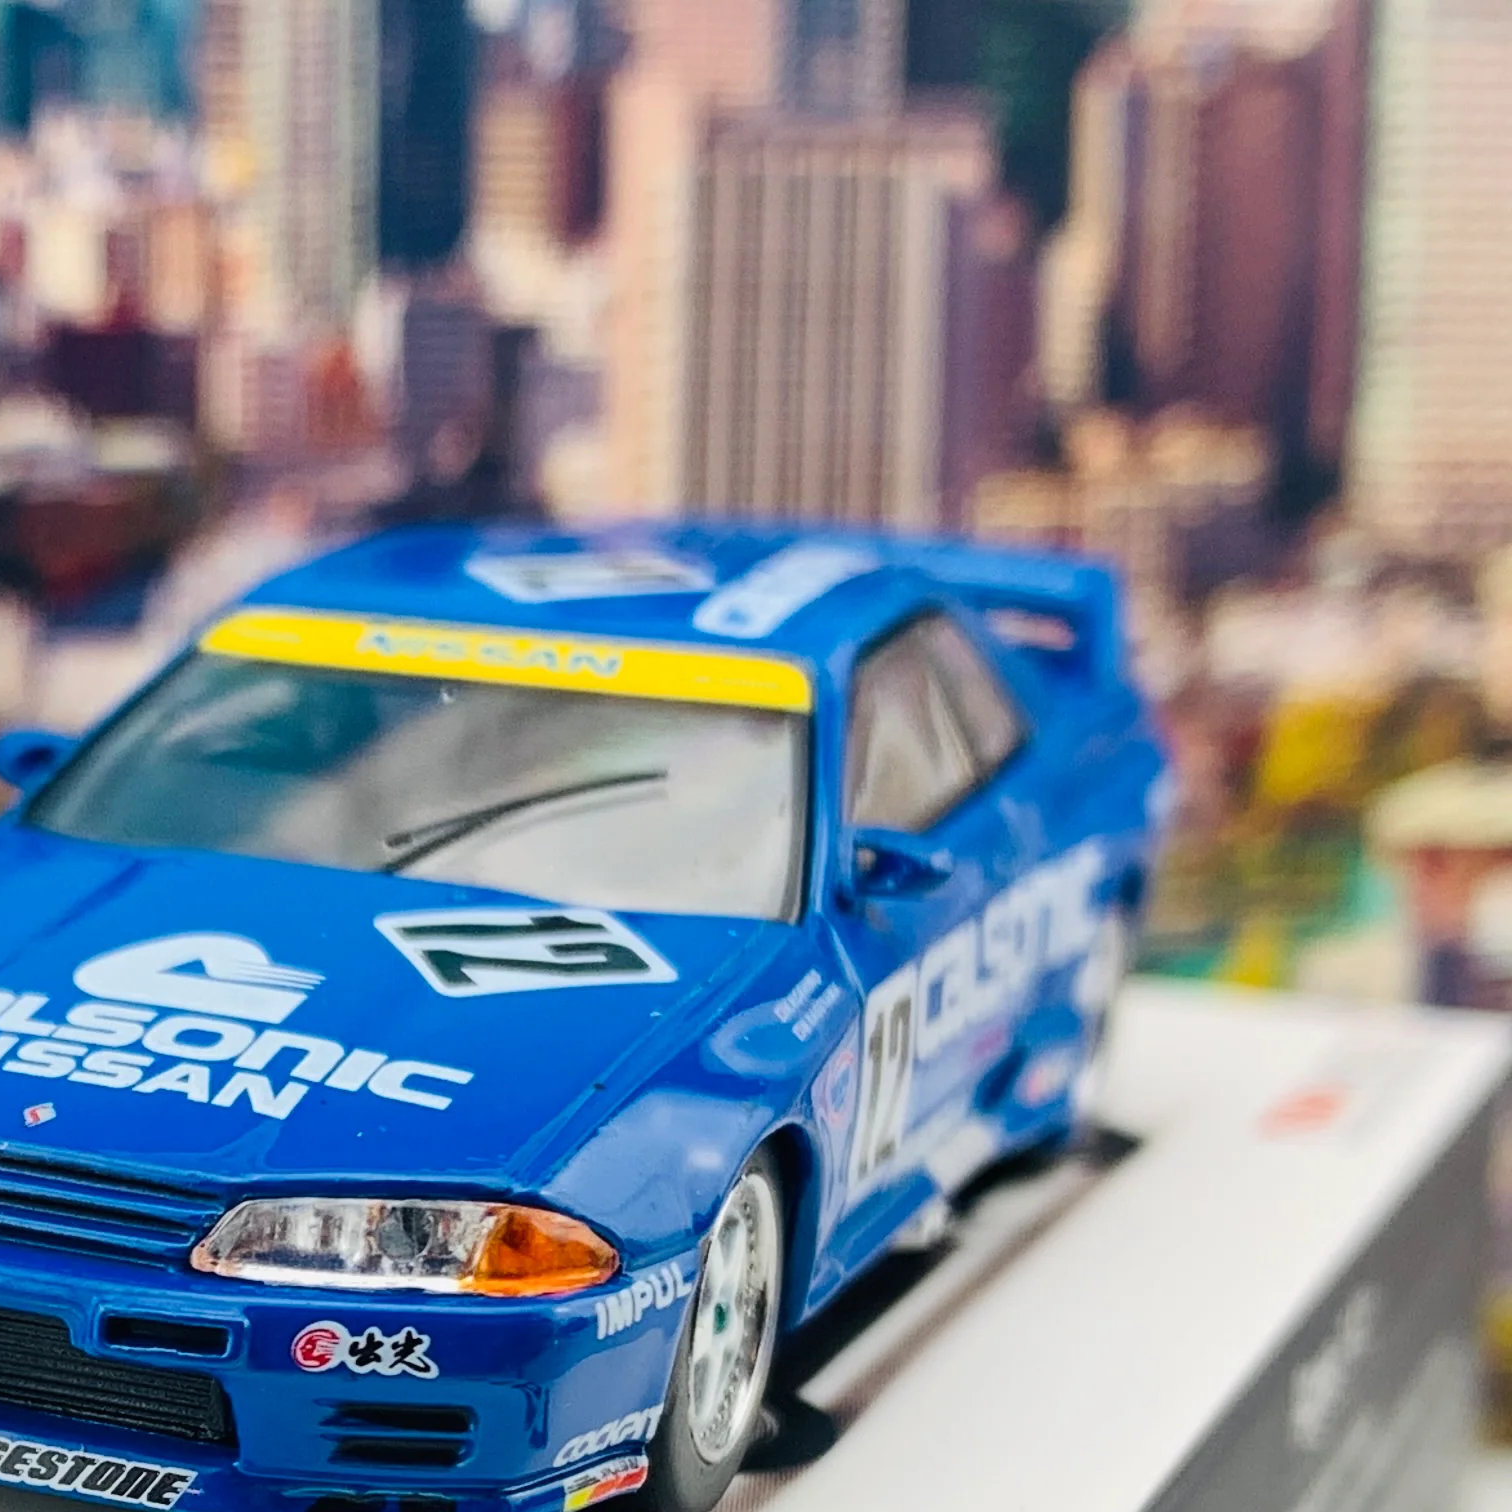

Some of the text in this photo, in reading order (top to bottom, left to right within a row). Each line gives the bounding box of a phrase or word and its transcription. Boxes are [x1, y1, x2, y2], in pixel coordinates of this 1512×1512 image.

[356, 625, 623, 680] NISSAN
[394, 913, 652, 989] 12
[856, 995, 913, 1180] 12
[595, 1260, 693, 1340] IMPUL
